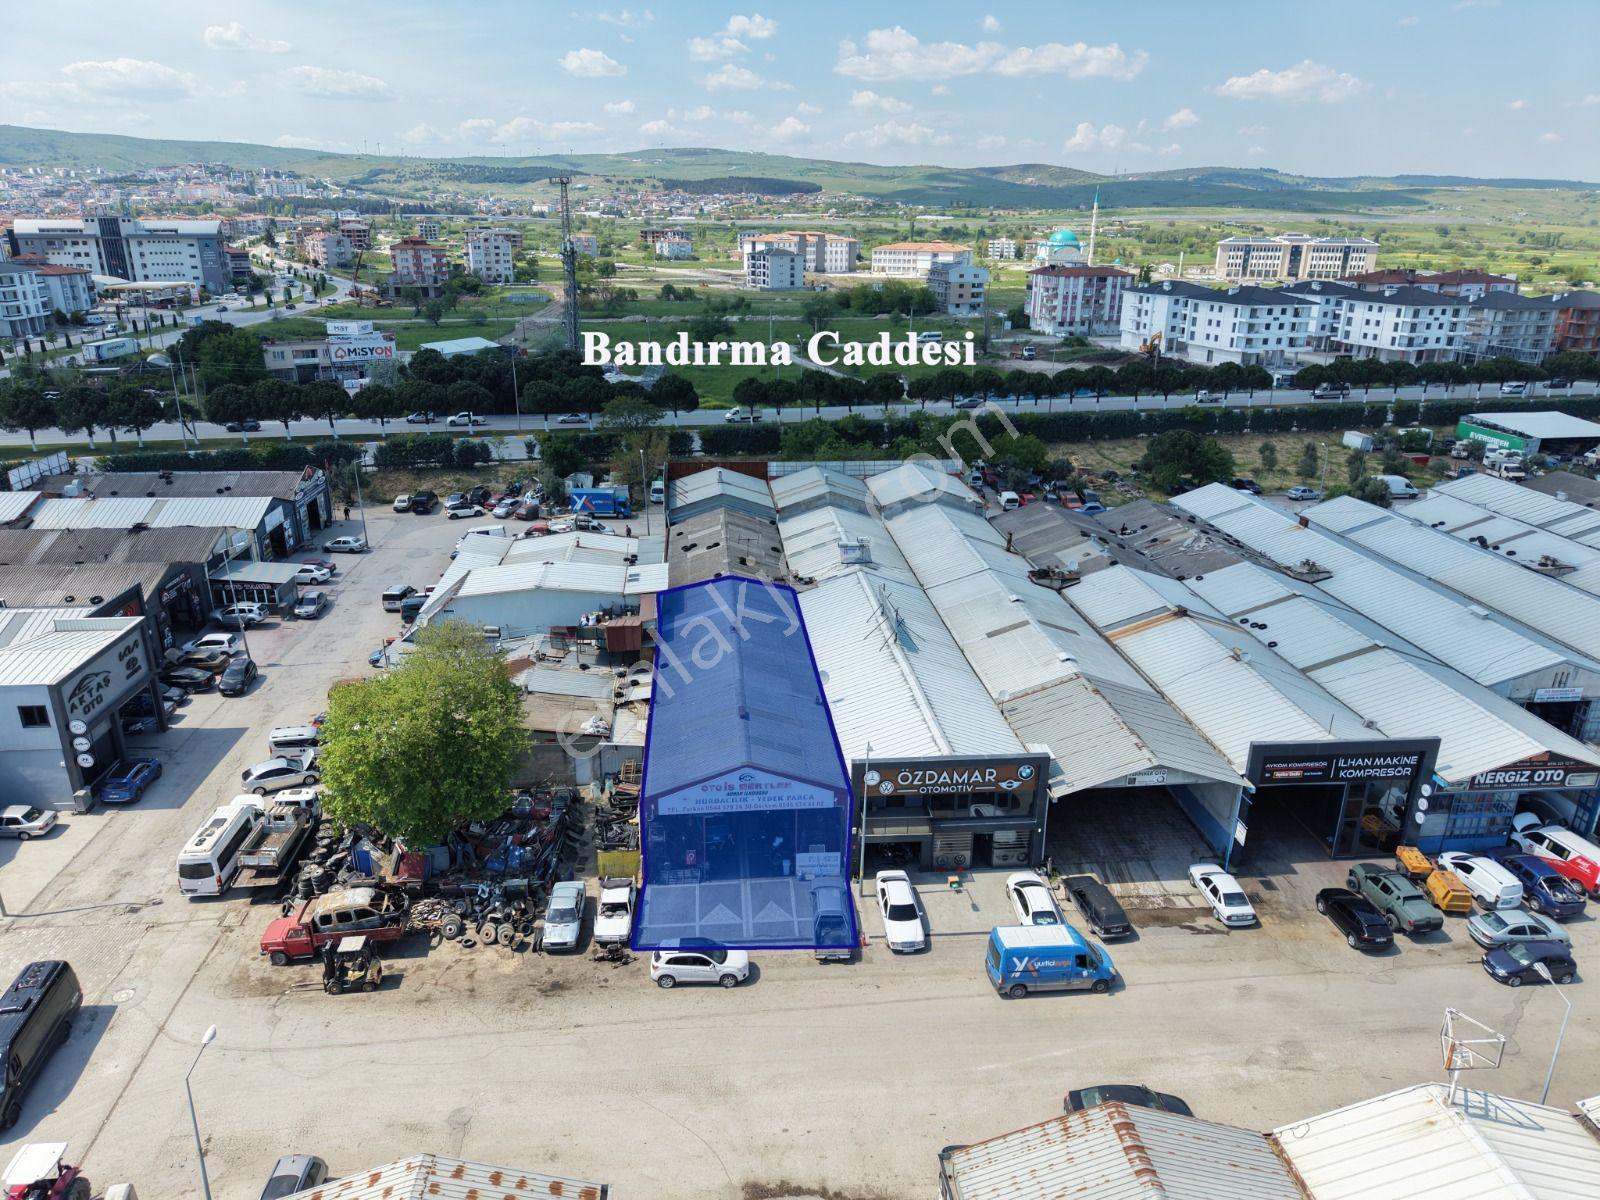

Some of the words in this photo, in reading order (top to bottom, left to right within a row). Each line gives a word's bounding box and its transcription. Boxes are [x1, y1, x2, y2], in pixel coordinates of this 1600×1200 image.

[1469, 431, 1510, 448] EVERGREEN
[83, 693, 104, 715] OTO
[1338, 756, 1373, 767] İLHAN
[1373, 755, 1419, 766] MAKİNE
[897, 768, 997, 785] ÖZDAMAR
[1339, 766, 1412, 778] KOMPRESÖR
[1533, 769, 1565, 784] OTO
[919, 784, 975, 794] OTOMOTİV
